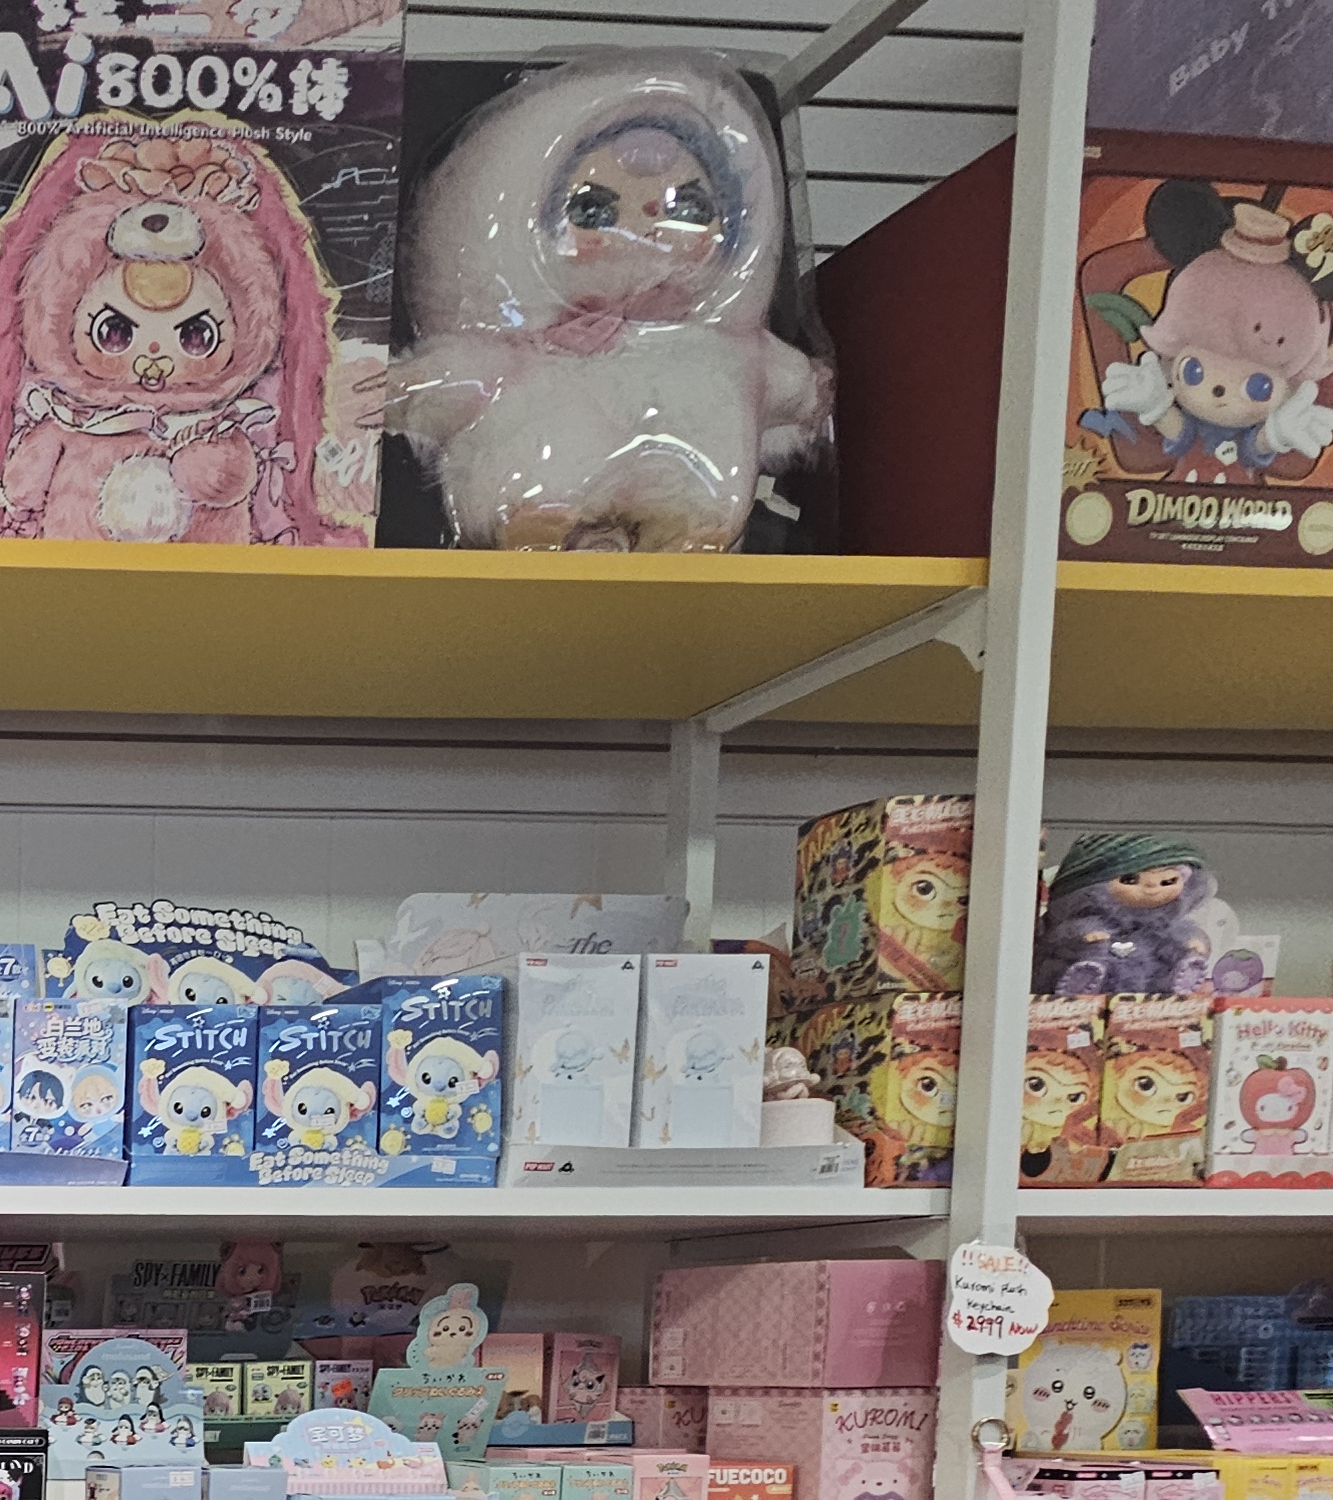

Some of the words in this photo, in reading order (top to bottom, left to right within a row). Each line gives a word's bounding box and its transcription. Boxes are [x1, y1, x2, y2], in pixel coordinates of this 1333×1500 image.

[17, 122, 61, 137] 800%
[67, 120, 135, 139] Artificial
[139, 122, 226, 142] Intelligence
[232, 126, 270, 142] Plush
[275, 128, 313, 144] Style
[1125, 488, 1218, 529] DIMOO
[1220, 498, 1294, 531] WORLD
[95, 900, 153, 928] Eat
[151, 900, 304, 944] Something
[119, 922, 213, 946] Before
[212, 929, 286, 958] Sleep
[155, 1023, 248, 1052] STITCH
[279, 1024, 372, 1053] STITCH
[1288, 1021, 1329, 1042] Kitty
[249, 1151, 289, 1173] Eat
[288, 1149, 389, 1175] Something
[954, 1276, 996, 1296] Kuromi
[966, 1299, 1015, 1314] Keychain
[1009, 1324, 1039, 1337] Now
[835, 1408, 928, 1436] KUROMI
[706, 1467, 787, 1486] FUECOCO
